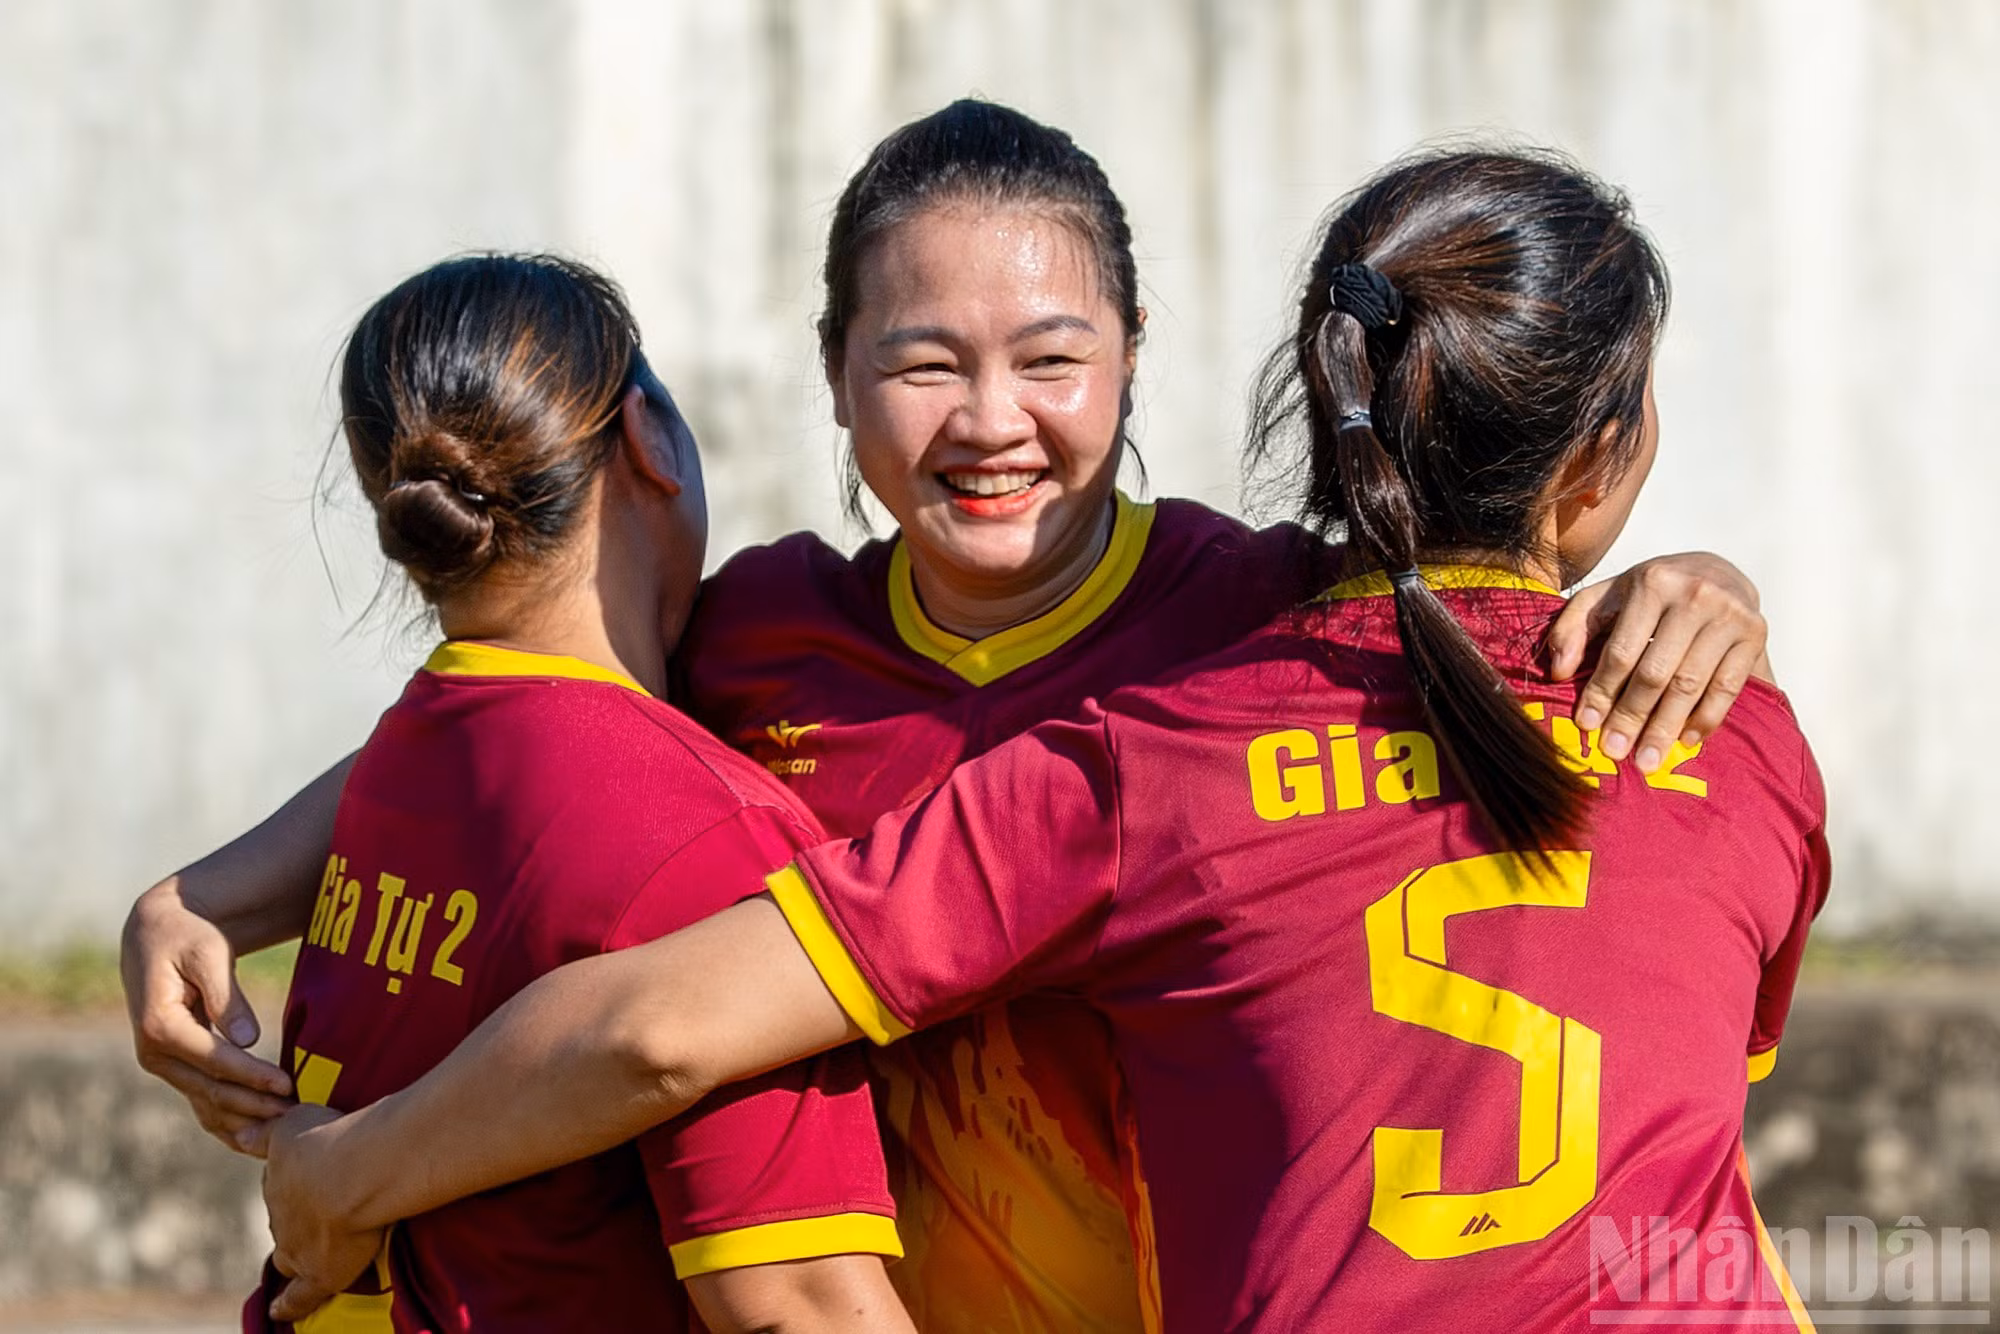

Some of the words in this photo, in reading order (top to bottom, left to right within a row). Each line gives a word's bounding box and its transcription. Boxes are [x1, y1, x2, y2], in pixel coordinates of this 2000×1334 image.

[1246, 723, 1441, 822] Gia
[306, 853, 363, 956] Gia
[363, 871, 435, 994] Tự
[430, 888, 479, 987] 2
[1363, 850, 1602, 1261] 5
